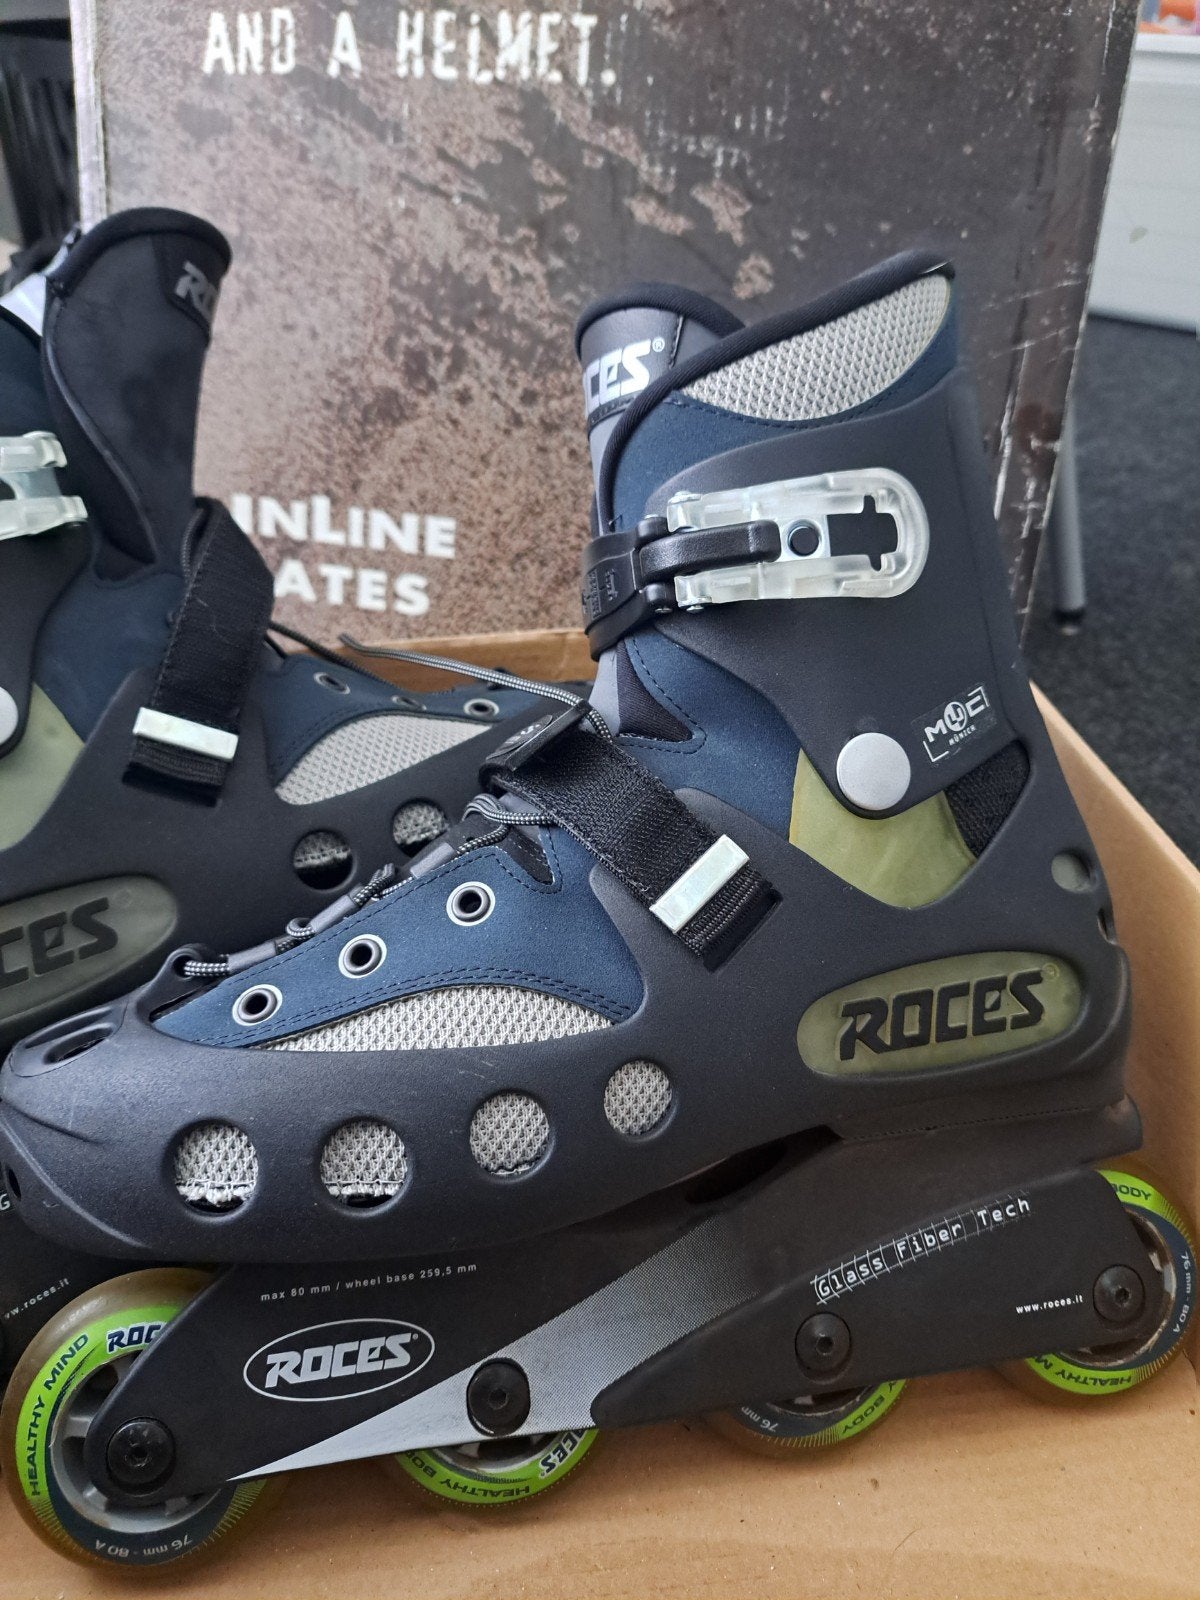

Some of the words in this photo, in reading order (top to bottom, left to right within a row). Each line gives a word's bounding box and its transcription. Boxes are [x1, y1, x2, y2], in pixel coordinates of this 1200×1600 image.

[203, 7, 296, 75] AND
[327, 10, 363, 79] A
[396, 9, 617, 86] HELMET.
[583, 339, 651, 414] CES
[231, 492, 457, 560] INLINE
[273, 557, 431, 616] ATES
[0, 896, 119, 990] CES
[839, 967, 1044, 1062] ROCES
[818, 1256, 885, 1298] Glass
[896, 1221, 963, 1260] Fiber
[976, 1197, 1031, 1227] Tech
[261, 1291, 286, 1301] max
[291, 1287, 305, 1298] 80
[310, 1284, 331, 1294] mm
[346, 1276, 381, 1290] wheel
[386, 1271, 415, 1284] base
[420, 1266, 452, 1280] 259,5
[457, 1263, 478, 1275] mm
[1015, 1294, 1084, 1315] www.roces.it
[107, 1323, 164, 1353] ROC
[264, 1332, 412, 1389] ROCES
[1055, 1369, 1132, 1386] HEALTHY
[26, 1394, 46, 1497] HEALTHY
[43, 1333, 90, 1391] MIND
[759, 1415, 780, 1433] 76
[842, 1394, 885, 1434] BODY
[541, 1429, 588, 1474] CES
[440, 1478, 530, 1498] HEALTHY
[94, 1539, 107, 1551] A
[107, 1544, 130, 1558] 80
[143, 1544, 169, 1556] mm
[170, 1534, 193, 1551] 76
